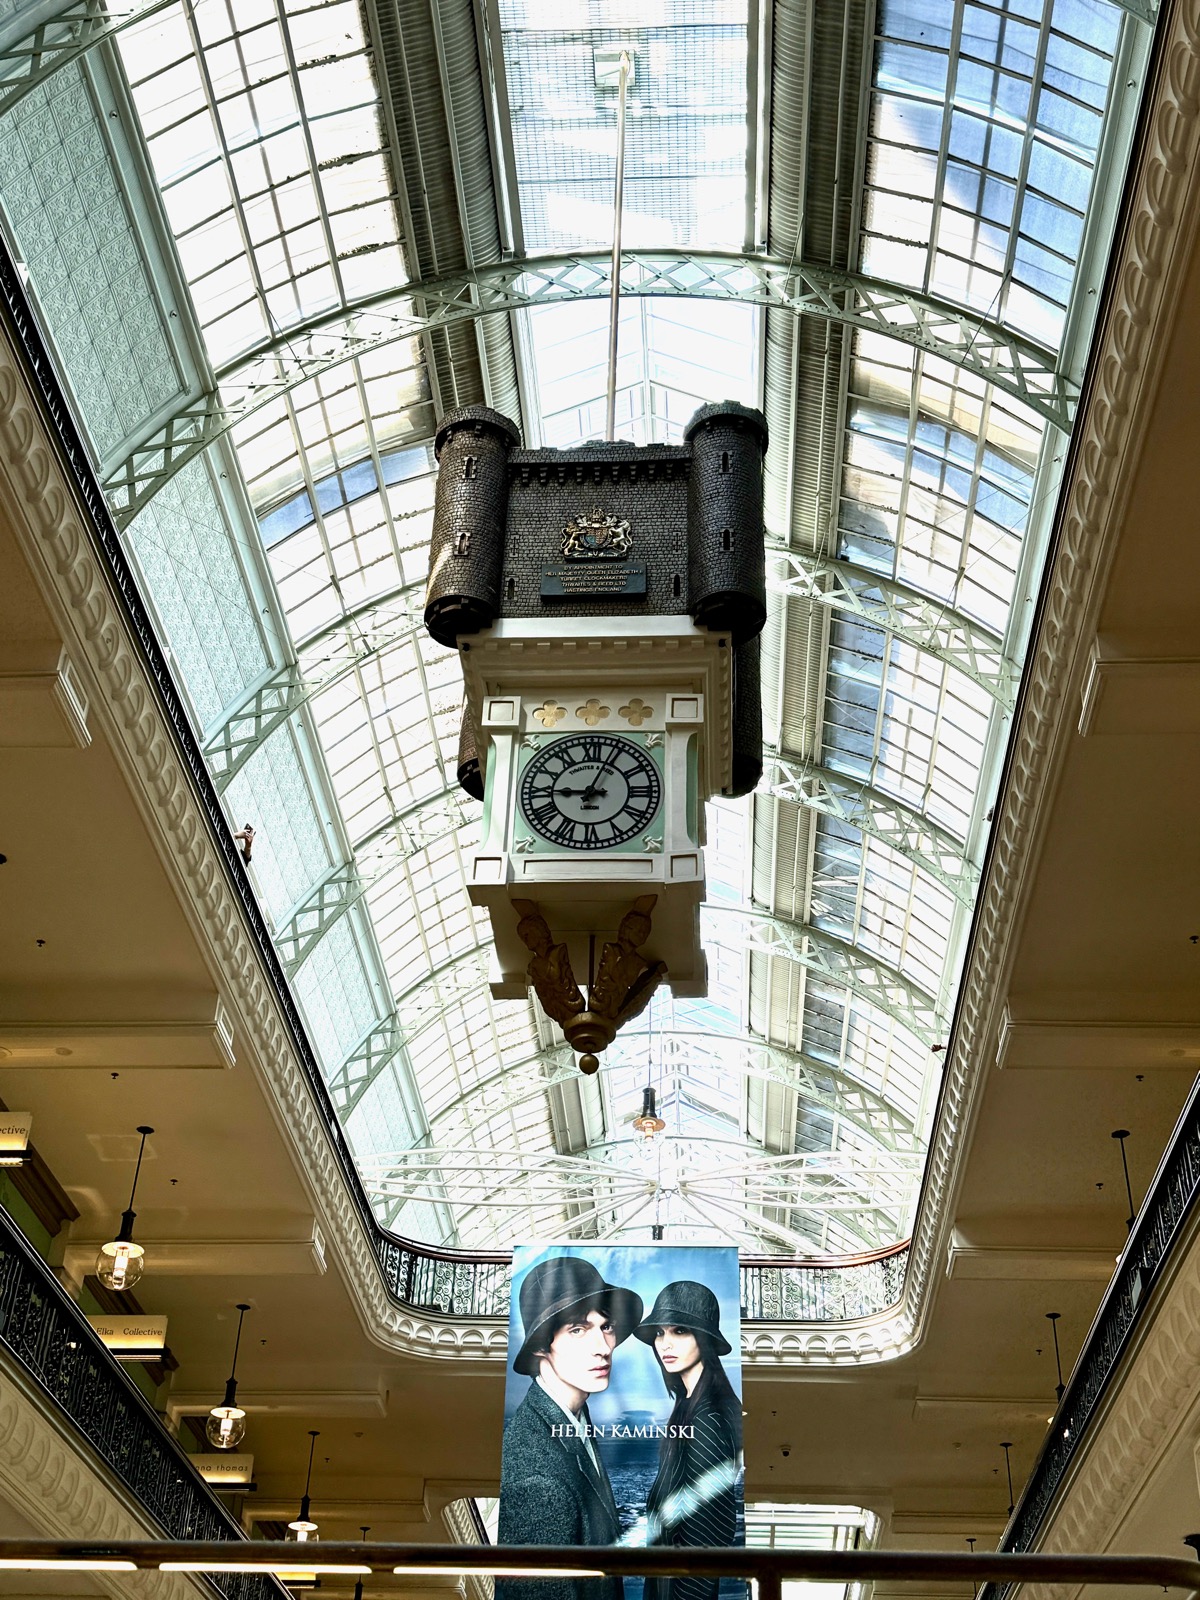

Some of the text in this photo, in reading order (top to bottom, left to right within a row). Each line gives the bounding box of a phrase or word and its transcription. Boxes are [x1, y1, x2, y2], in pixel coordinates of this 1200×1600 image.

[582, 742, 602, 762] XII
[538, 763, 559, 781] X
[624, 763, 646, 780] II
[530, 785, 552, 799] IX
[629, 785, 651, 799] III
[96, 1327, 162, 1336] Elka Collective
[550, 1424, 695, 1438] HELEN KAMINSKI
[216, 1464, 248, 1472] thomas
